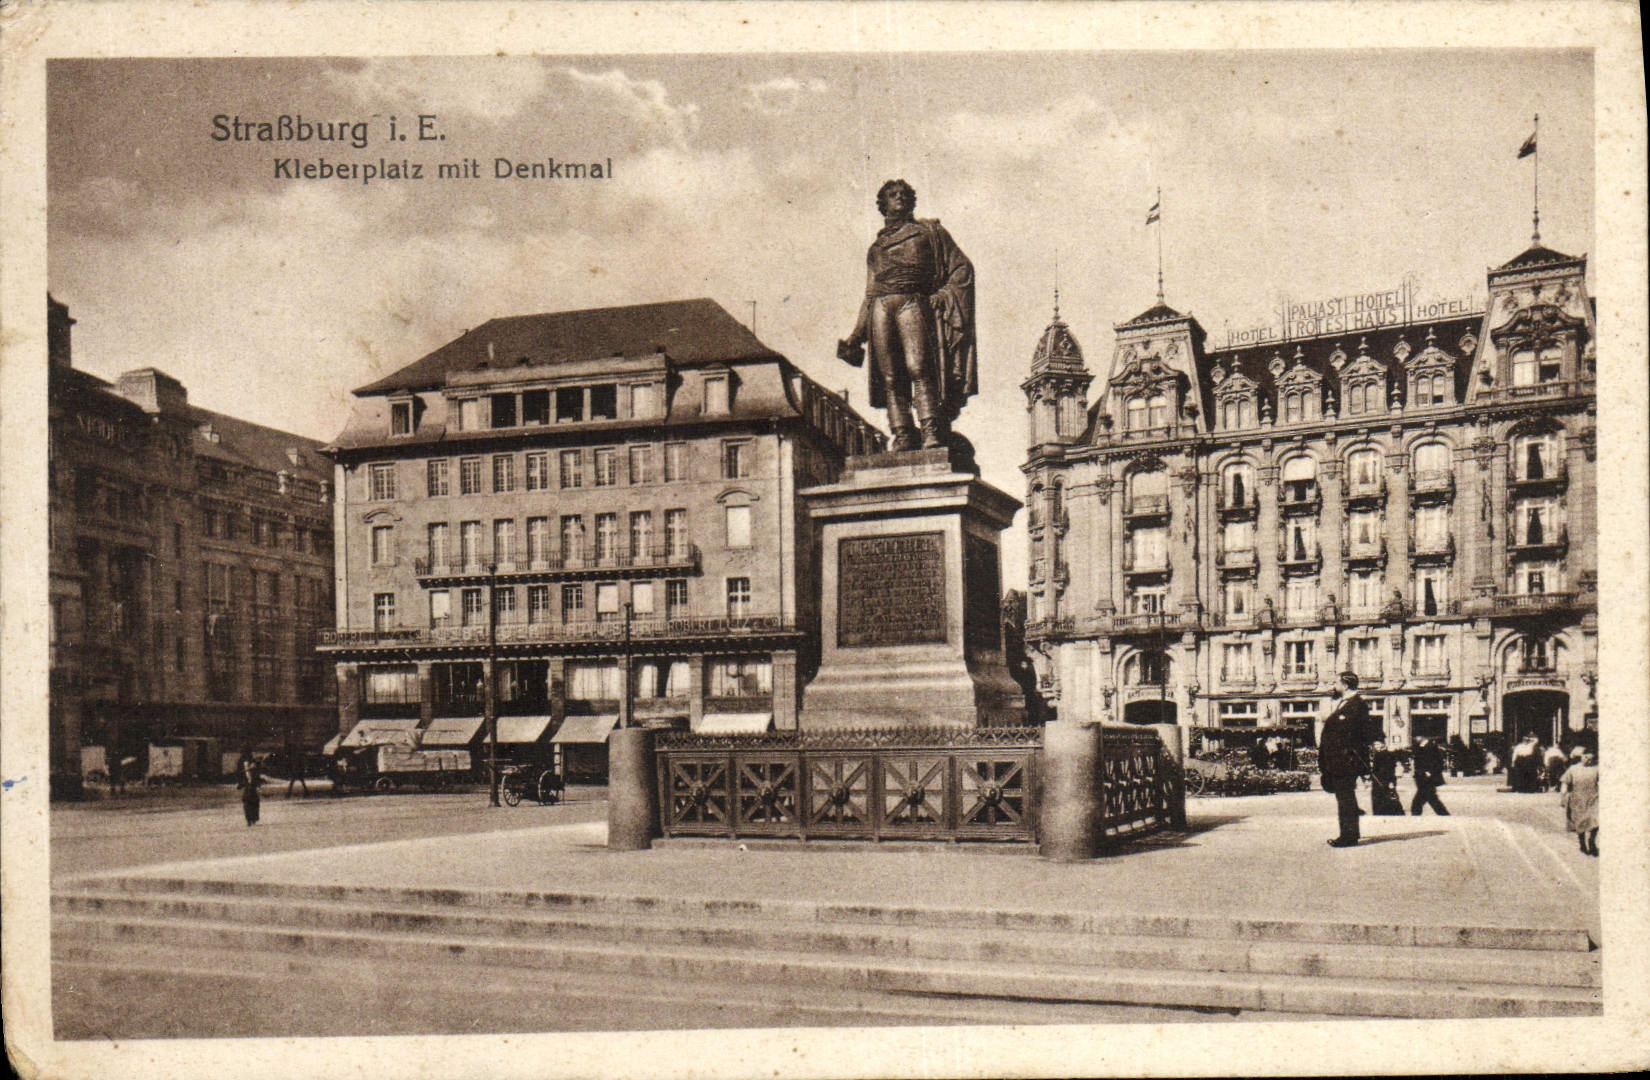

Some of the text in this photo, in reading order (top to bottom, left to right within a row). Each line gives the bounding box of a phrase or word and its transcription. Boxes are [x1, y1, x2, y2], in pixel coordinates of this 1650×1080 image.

[1291, 290, 1404, 321] PALAST HOTEL
[1416, 299, 1469, 318] HOTEL
[1230, 326, 1278, 343] HOTEL
[1296, 308, 1398, 338] ROTES HAUS
